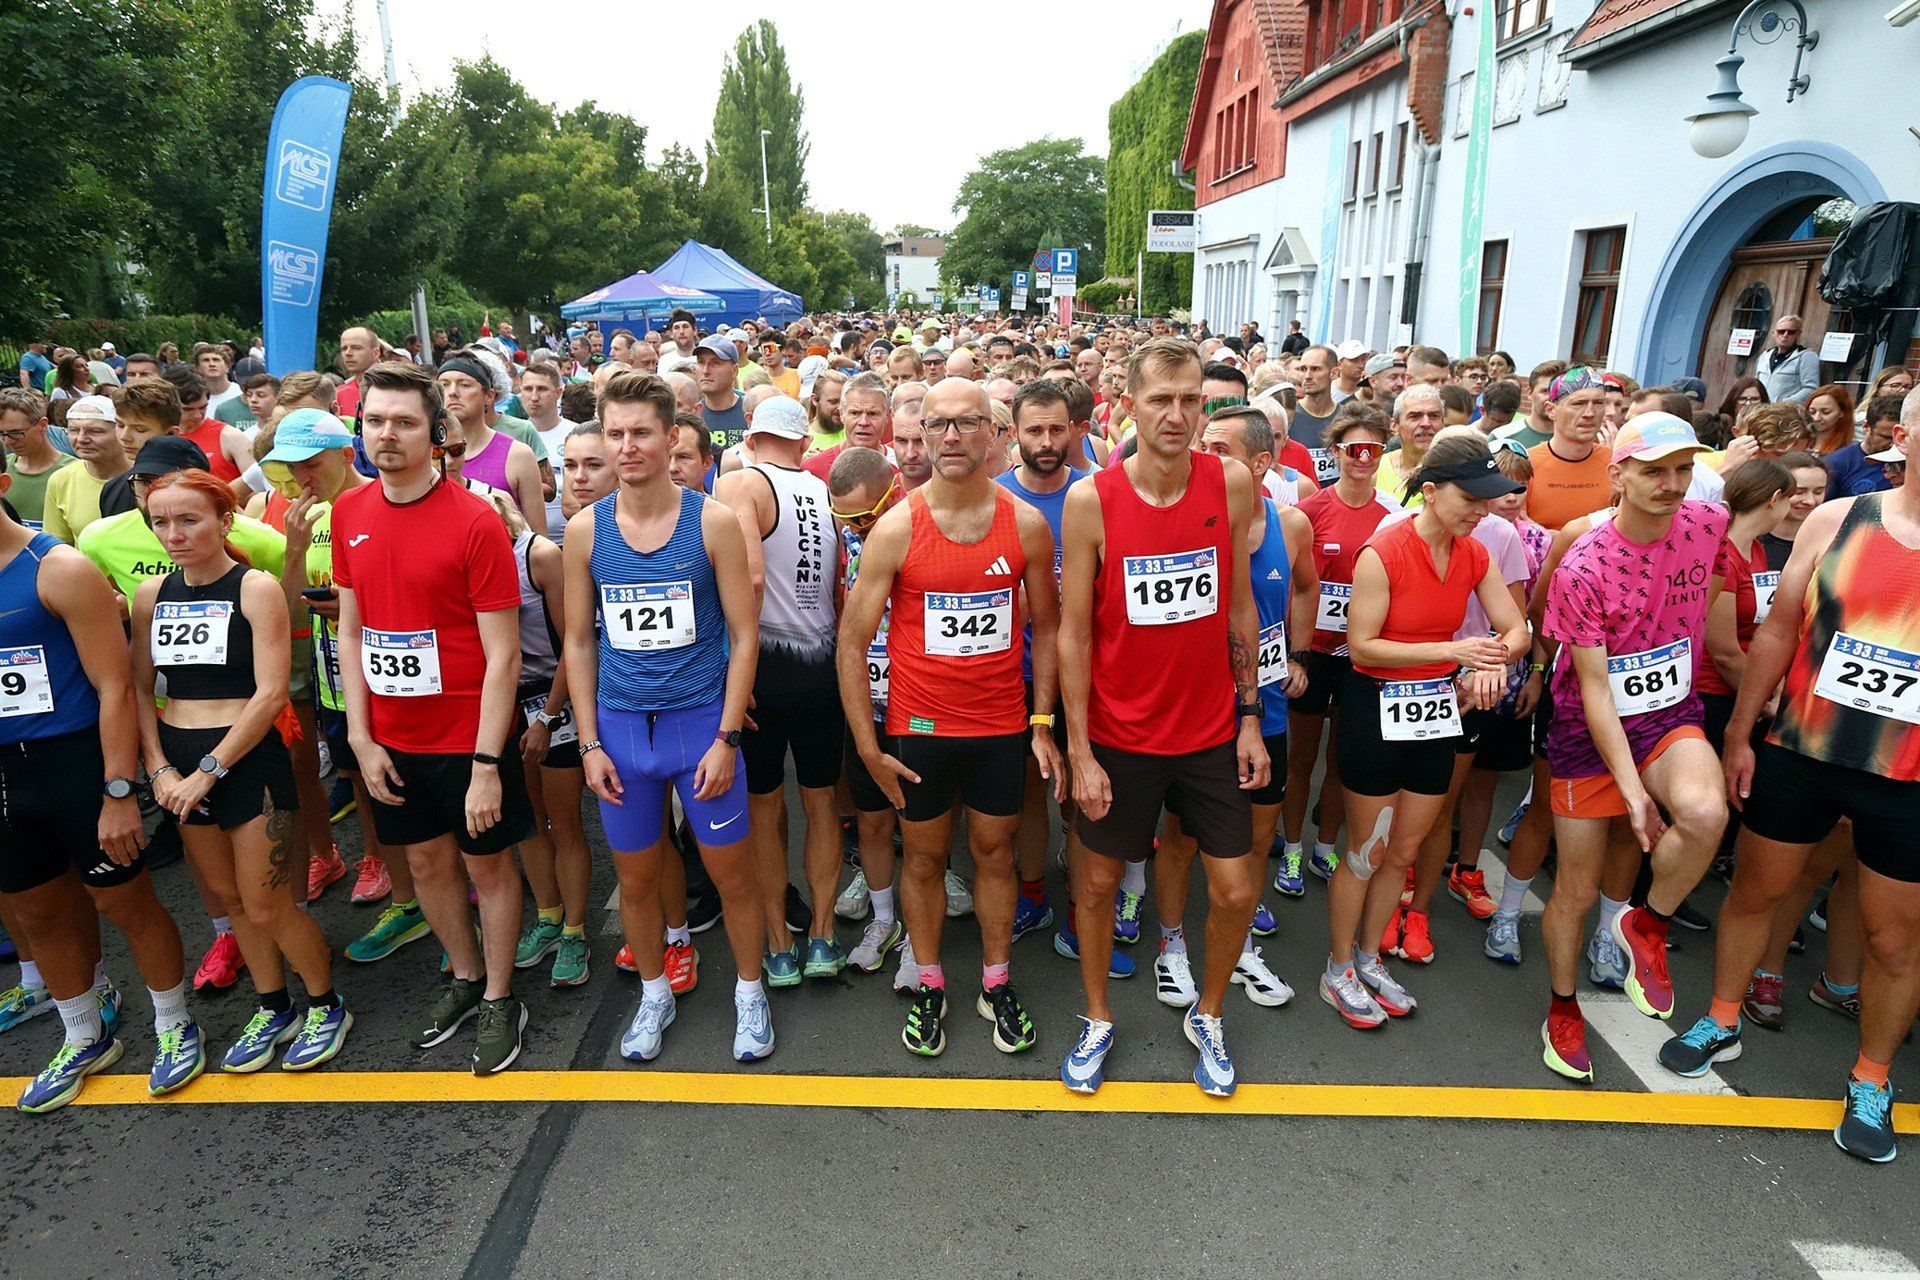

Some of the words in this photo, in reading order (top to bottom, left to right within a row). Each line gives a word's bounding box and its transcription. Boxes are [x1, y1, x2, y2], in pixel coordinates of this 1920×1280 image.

[1057, 251, 1072, 272] P
[1016, 273, 1026, 286] P
[805, 496, 822, 583] RUNNERS
[1133, 573, 1212, 605] 1876
[944, 597, 960, 609] 33.
[619, 606, 674, 631] 121
[941, 613, 997, 637] 342
[157, 623, 210, 646] 526
[370, 652, 421, 677] 538
[1, 672, 26, 696] 9
[1623, 664, 1679, 697] 681
[1836, 661, 1919, 698] 237
[1387, 698, 1452, 723] 1925
